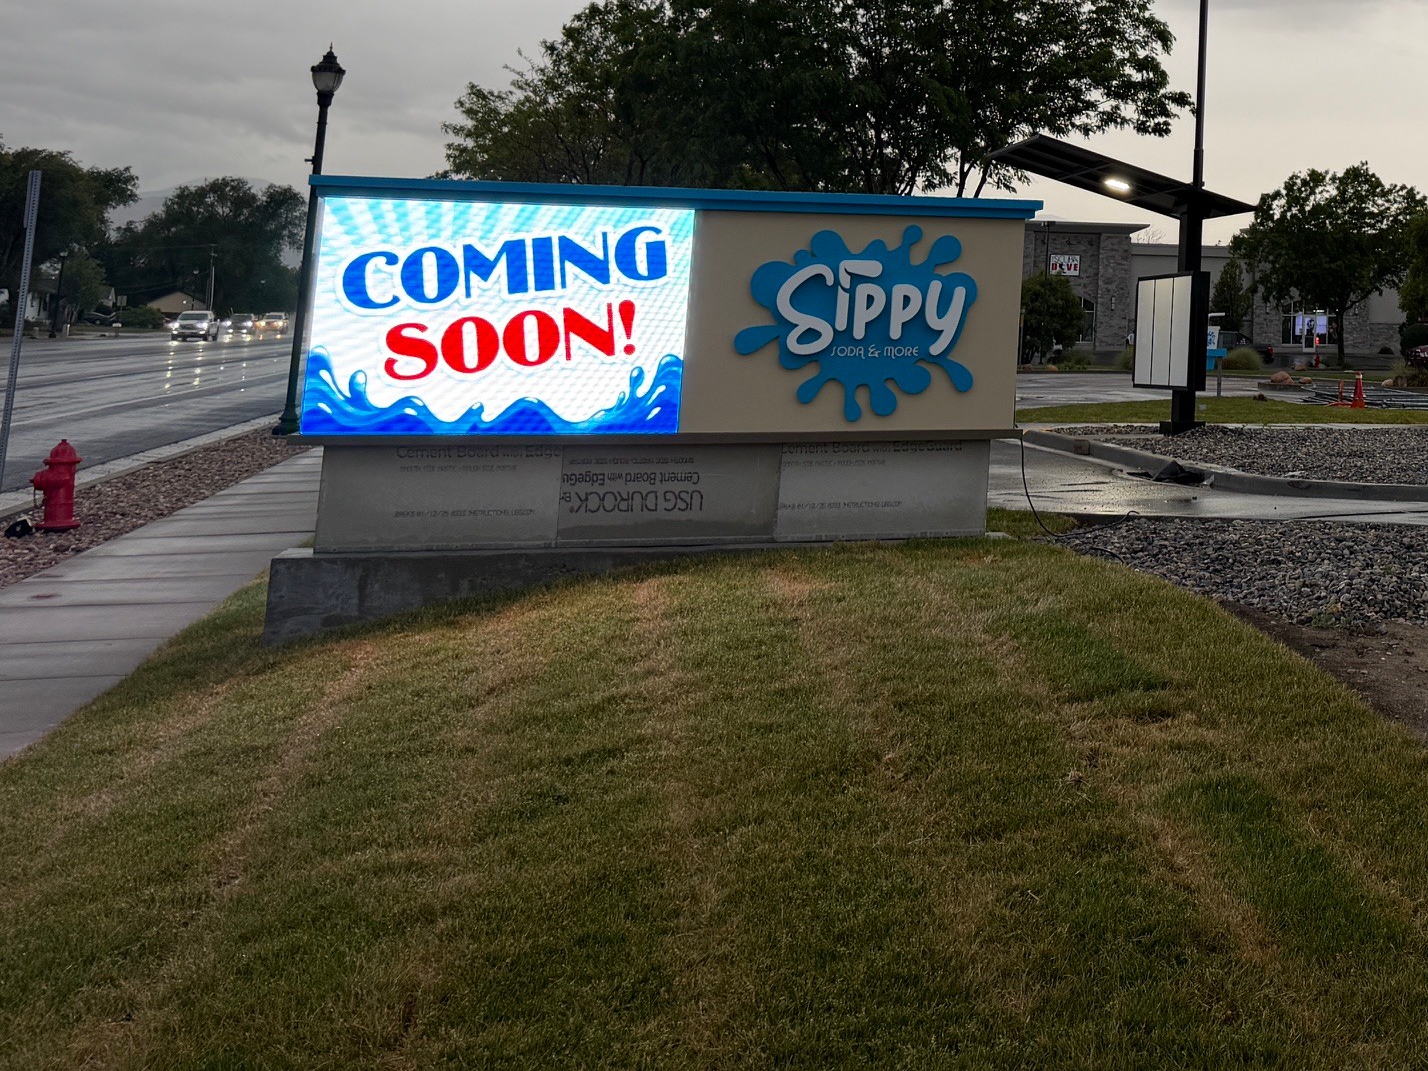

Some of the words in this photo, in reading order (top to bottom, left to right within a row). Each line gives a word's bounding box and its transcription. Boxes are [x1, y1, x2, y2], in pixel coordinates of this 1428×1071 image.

[341, 225, 669, 309] COMING
[384, 299, 636, 381] SOON!
[831, 346, 865, 359] SODA
[868, 344, 881, 358] &
[884, 346, 919, 359] MORE
[397, 445, 452, 459] Cement
[457, 444, 499, 458] Board
[607, 472, 624, 482] with
[624, 472, 657, 486] Board
[659, 472, 700, 485] Cement
[663, 490, 704, 512] USG
